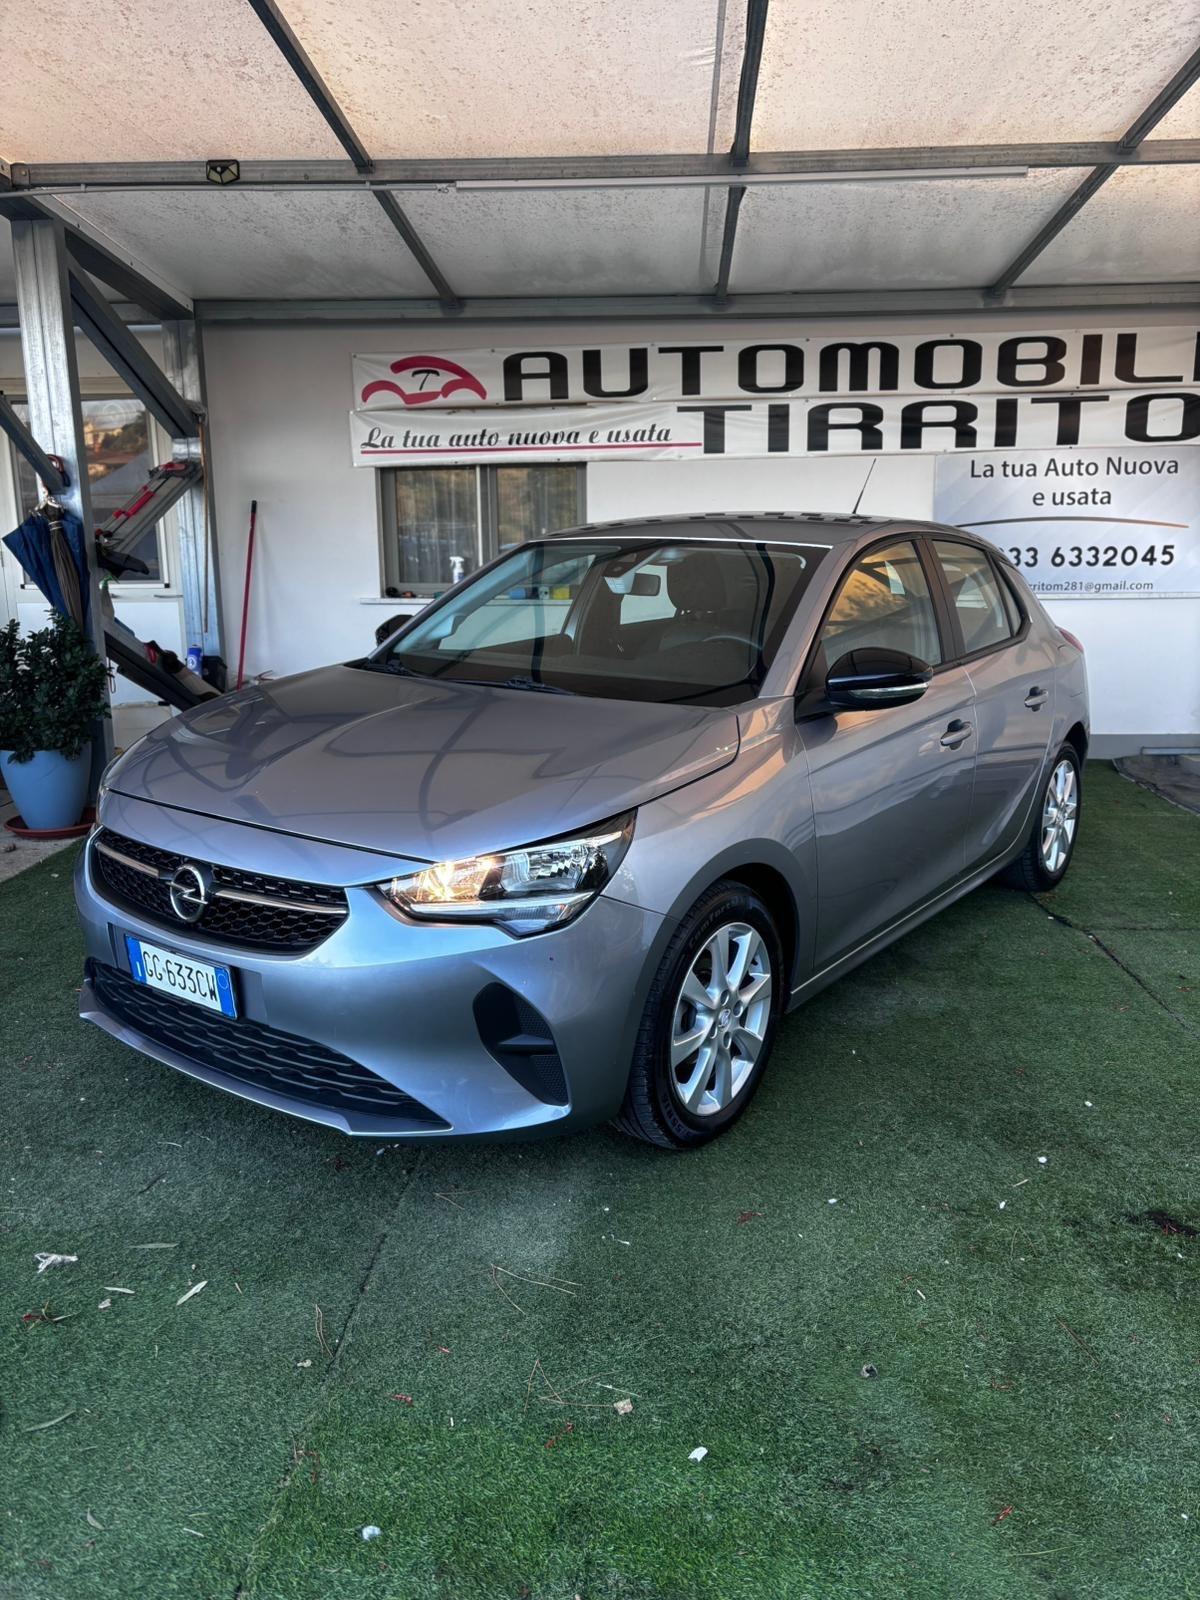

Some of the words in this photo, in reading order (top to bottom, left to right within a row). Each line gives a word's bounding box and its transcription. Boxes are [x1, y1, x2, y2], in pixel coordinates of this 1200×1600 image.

[677, 392, 1200, 454] TIRRITO
[360, 426, 395, 449] La
[402, 430, 440, 448] tua
[449, 428, 500, 447] auto
[507, 430, 581, 447] nuova
[588, 430, 600, 444] e
[606, 424, 672, 443] usata
[970, 459, 994, 478] La
[1001, 460, 1037, 477] tua
[1044, 458, 1099, 477] Auto
[1106, 456, 1179, 476] Nuova
[1032, 491, 1045, 506] e
[1052, 488, 1112, 506] usata
[1000, 547, 1038, 568] 33
[1050, 544, 1175, 568] 6332045
